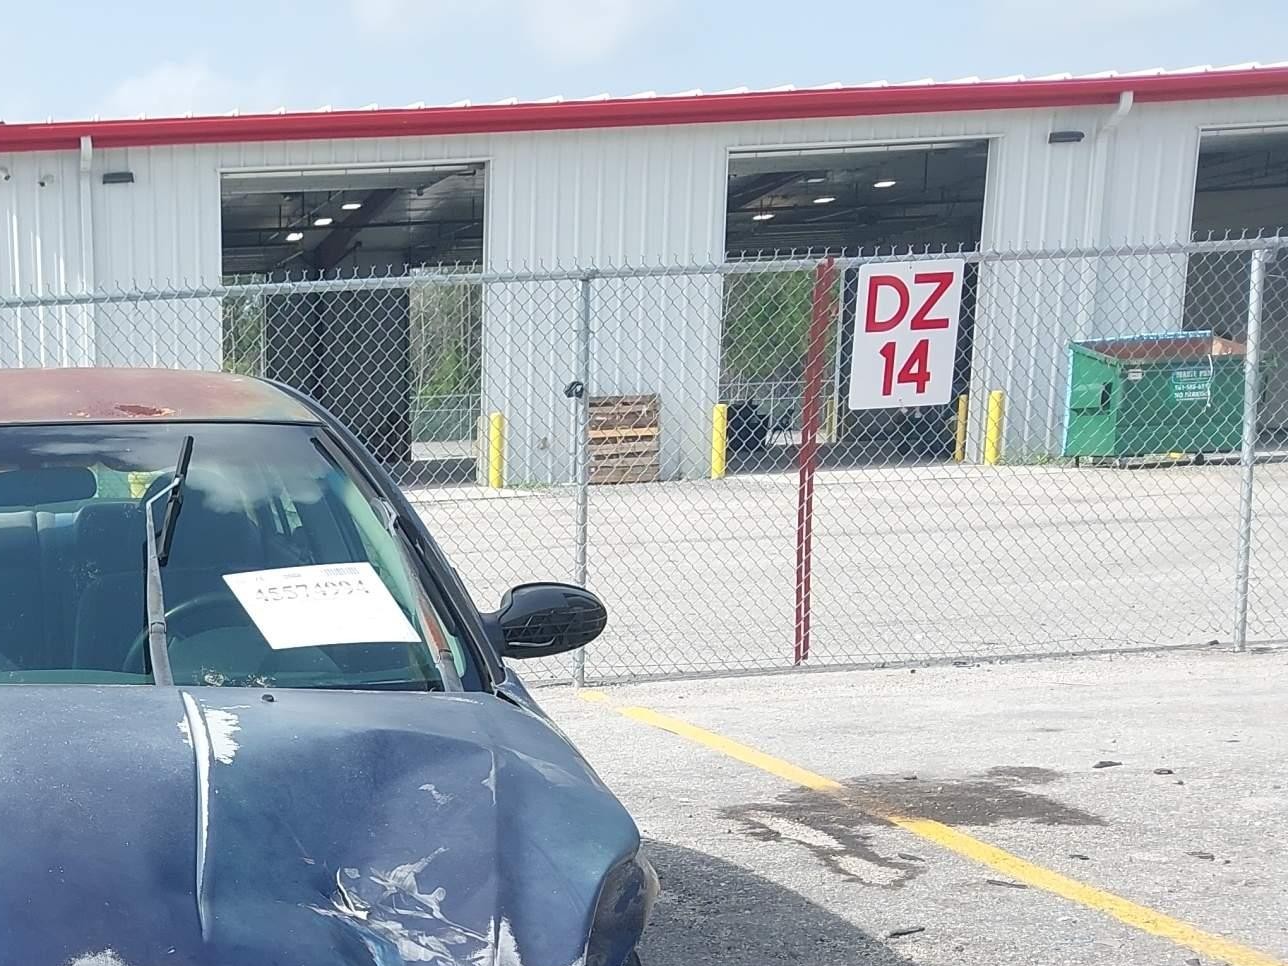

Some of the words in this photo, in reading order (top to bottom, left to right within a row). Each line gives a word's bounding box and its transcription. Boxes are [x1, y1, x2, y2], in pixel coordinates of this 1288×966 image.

[865, 271, 954, 333] DZ
[879, 339, 931, 396] 14
[255, 579, 371, 602] 45574994
